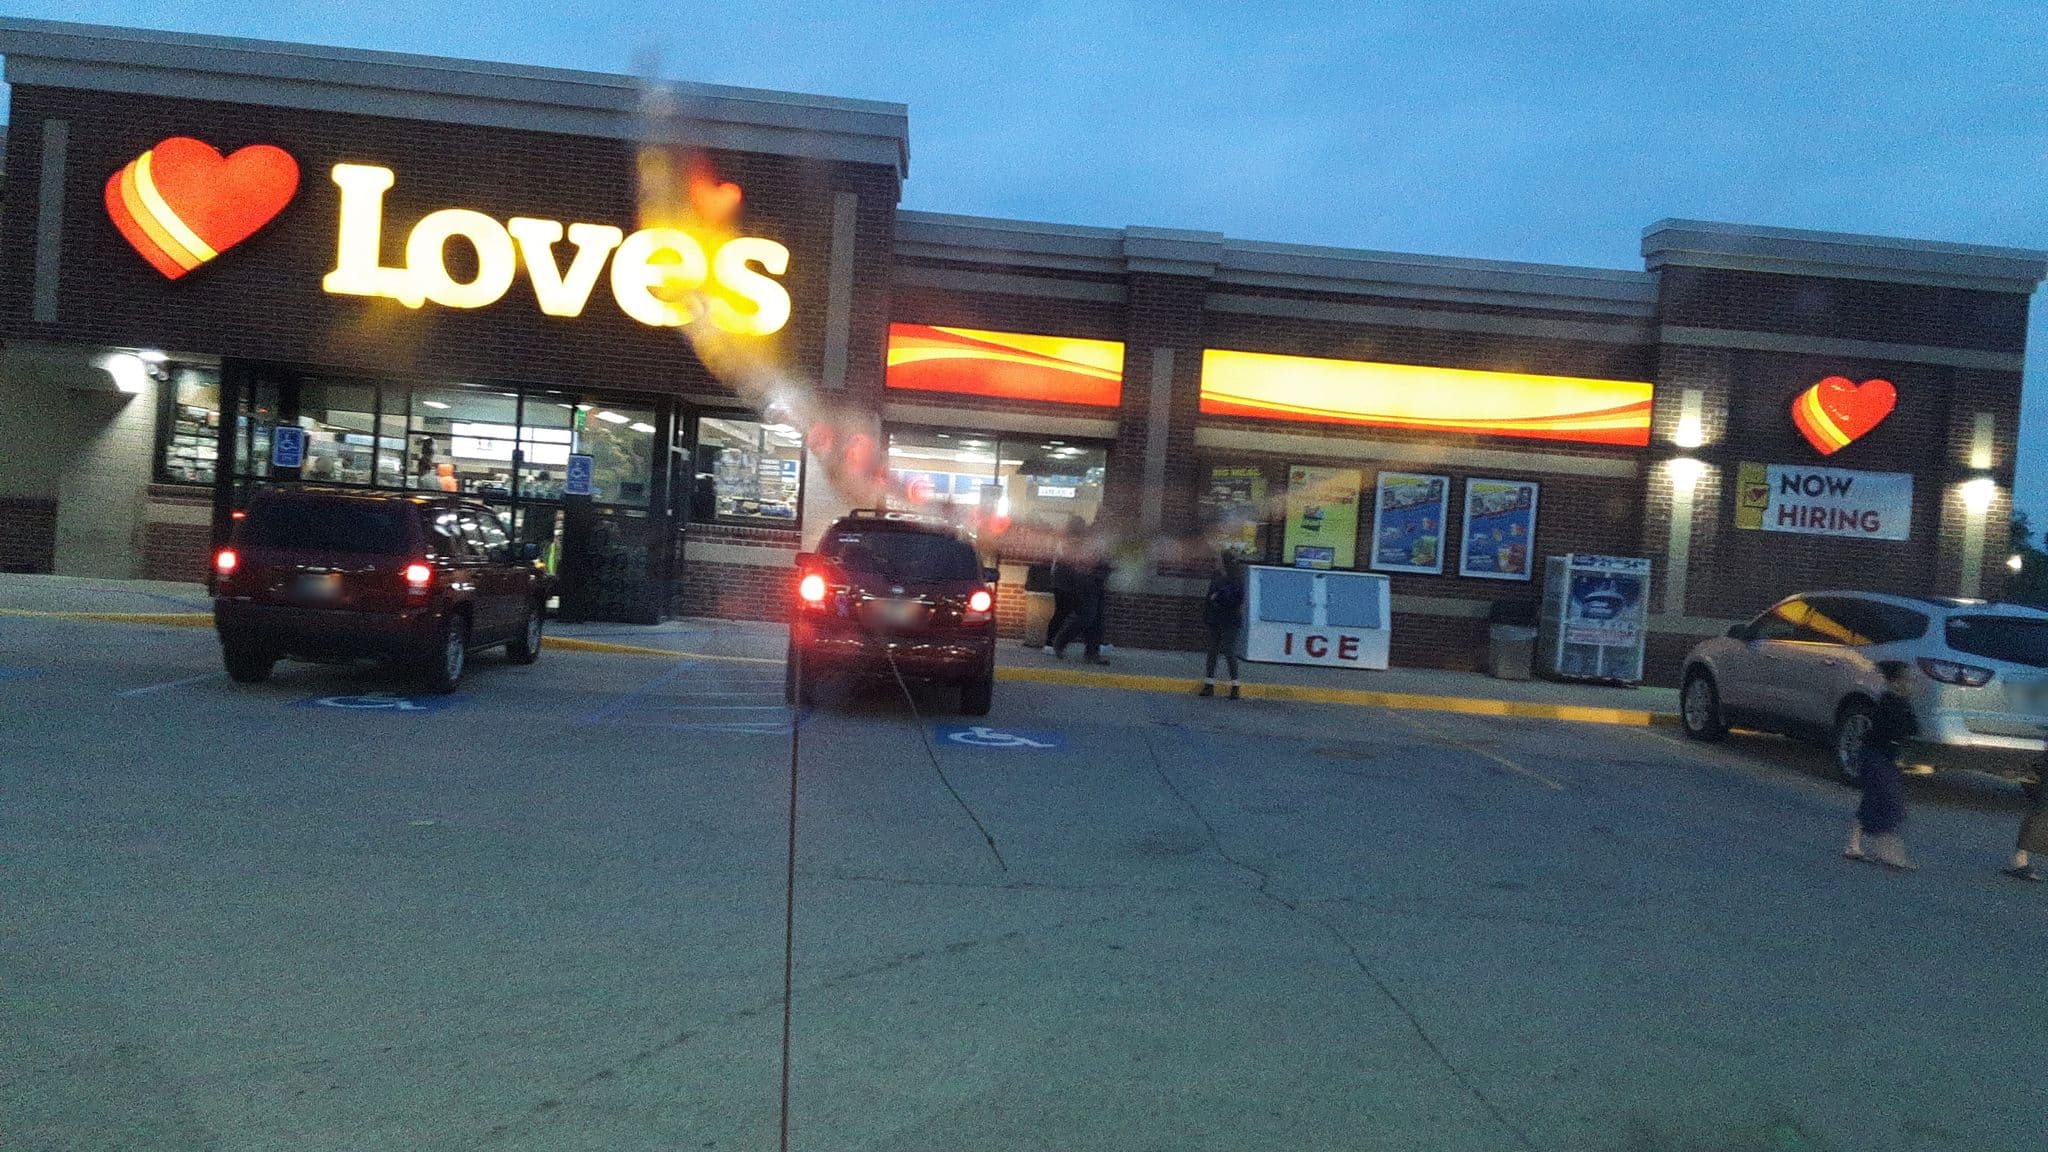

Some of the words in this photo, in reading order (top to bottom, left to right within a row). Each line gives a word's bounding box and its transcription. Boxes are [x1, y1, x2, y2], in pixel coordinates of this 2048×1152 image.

[1780, 473, 1853, 498] NOW
[1777, 503, 1881, 533] HIRING
[1284, 632, 1360, 661] ICE
